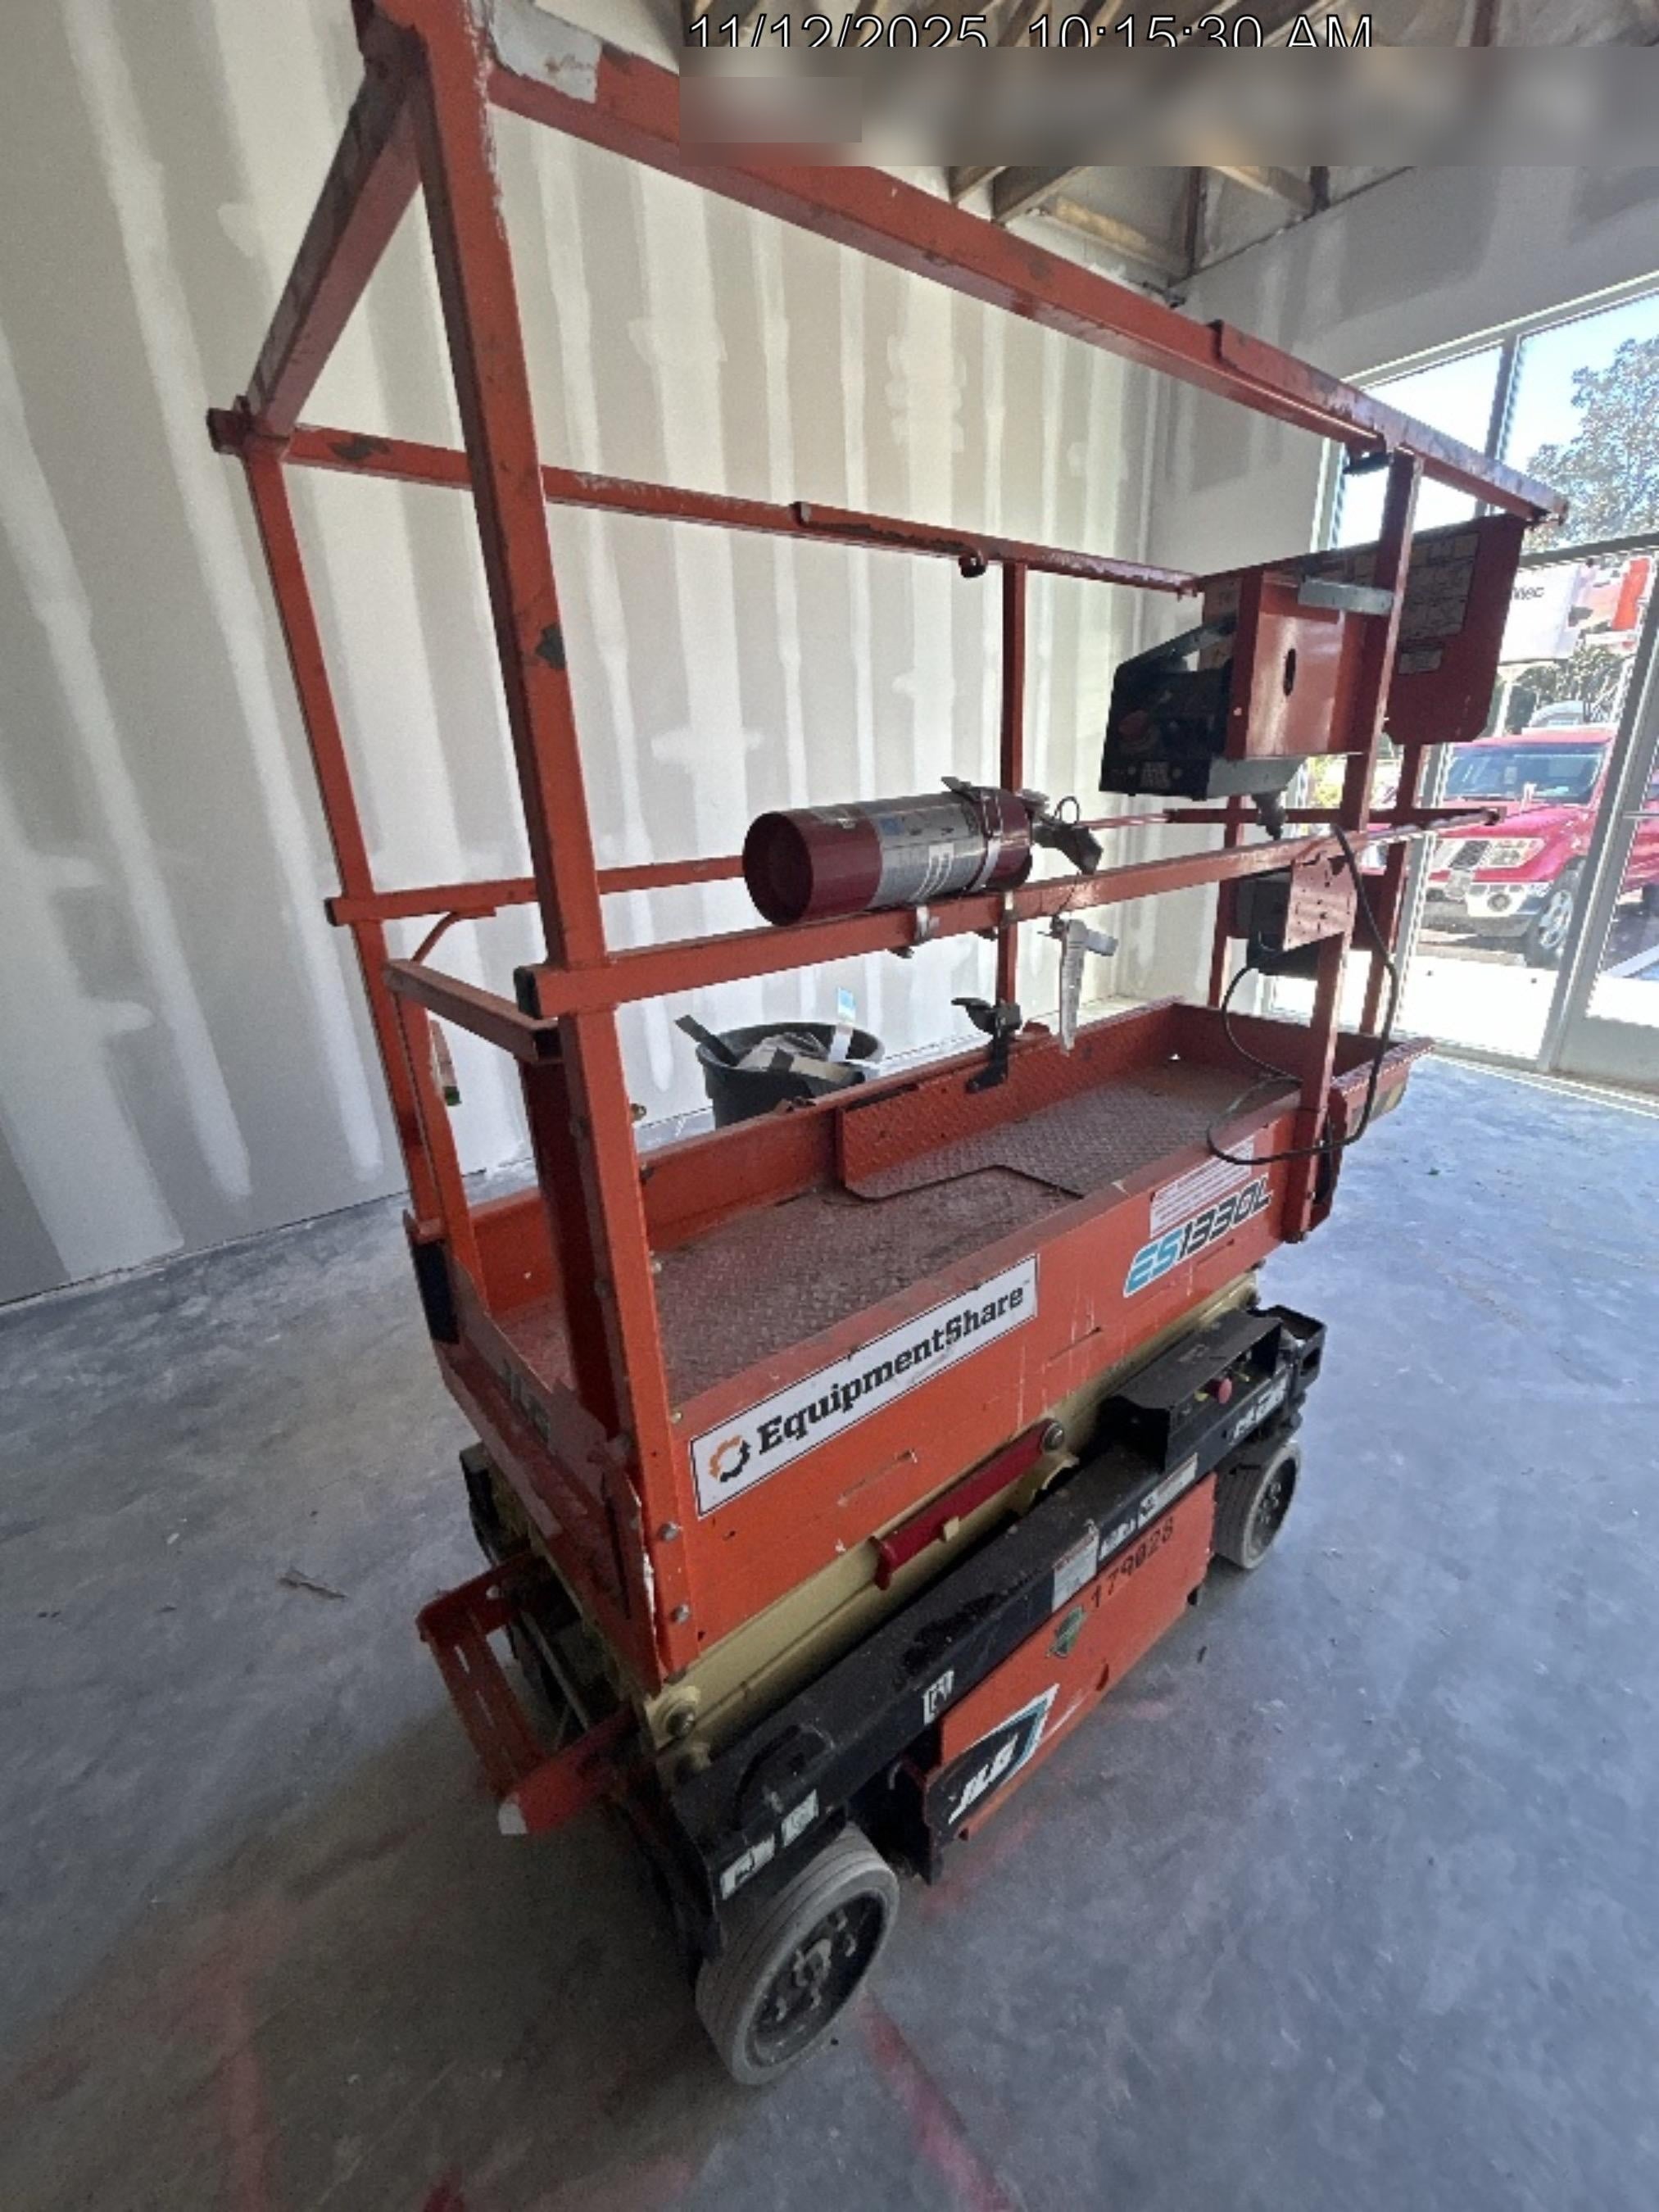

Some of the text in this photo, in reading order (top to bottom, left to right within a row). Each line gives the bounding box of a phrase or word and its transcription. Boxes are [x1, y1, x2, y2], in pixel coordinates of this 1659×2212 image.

[1126, 1176, 1271, 1291] ES1330L
[757, 1285, 1024, 1455] EquipmentShare
[1090, 1516, 1174, 1608] 179028
